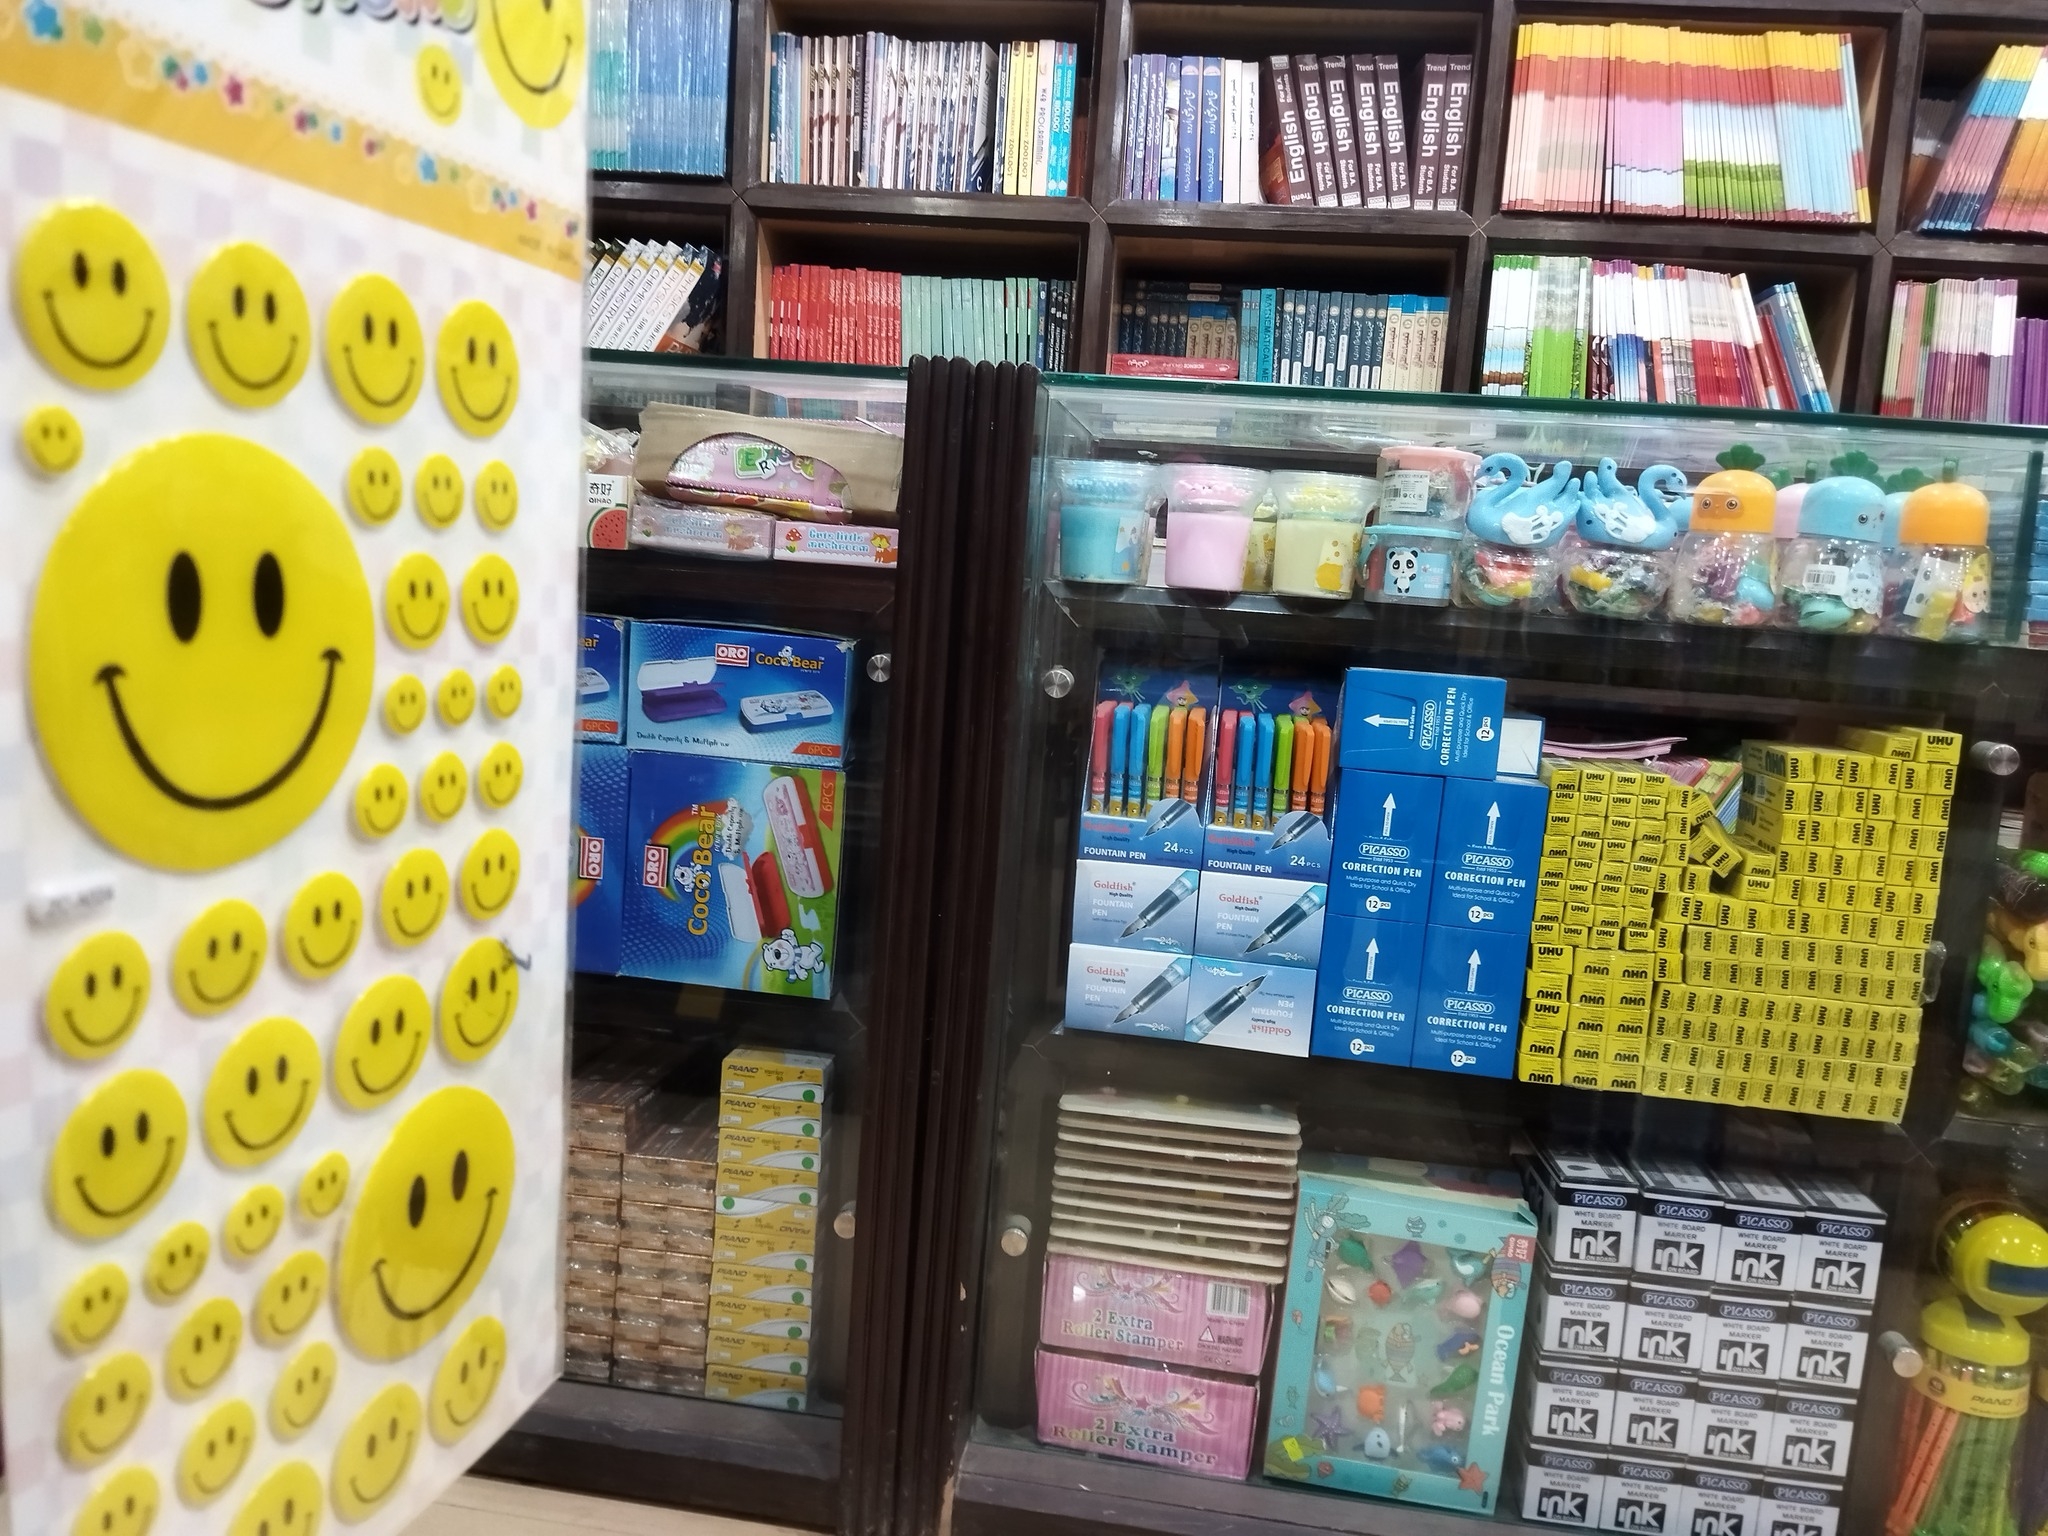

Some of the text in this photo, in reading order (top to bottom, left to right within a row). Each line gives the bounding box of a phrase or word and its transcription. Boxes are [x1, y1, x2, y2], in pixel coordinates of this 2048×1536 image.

[1299, 63, 1318, 72] Trend
[1052, 100, 1061, 134] BIOLOGY
[1062, 100, 1071, 134] BIOLOGY
[1305, 82, 1328, 154] English
[1330, 80, 1352, 152] English
[1359, 82, 1380, 155] English
[1382, 82, 1404, 154] English
[1421, 84, 1443, 157] English
[1445, 83, 1467, 156] English
[1281, 110, 1305, 183] English
[1021, 140, 1029, 179] ZOOLOGY
[1316, 162, 1324, 191] Students
[1418, 165, 1426, 194] Students
[1442, 164, 1450, 194] Students
[1291, 193, 1311, 202] Trend
[606, 268, 642, 322] CHEMISTRY
[624, 268, 659, 323] CHEMISTRY
[662, 273, 696, 321] PHYSICS
[1262, 293, 1272, 364] MATHEMATICAL
[717, 645, 824, 670] ORO Coco Bear
[585, 722, 611, 732] 6PCS
[1422, 703, 1434, 747] PICASSO
[1440, 687, 1456, 765] CORRECTION PEN
[1481, 730, 1489, 739] 12
[1927, 735, 1954, 746] UHU
[808, 745, 832, 756] 6PCS
[1791, 758, 1799, 779] UHU
[1586, 773, 1605, 781] UHU
[1617, 776, 1636, 784] UHU
[1646, 775, 1665, 784] UHU
[824, 782, 833, 812] 6PCS
[1612, 820, 1631, 828] UHU
[1084, 847, 1146, 860] FOUNTAIN PEN
[1163, 842, 1178, 853] 24
[1362, 845, 1406, 857] PICASSO
[588, 840, 600, 876] ORO
[1290, 856, 1305, 867] 24
[1465, 854, 1510, 867] PICASSO
[1713, 852, 1729, 867] UHU
[646, 849, 660, 884] ORO
[687, 806, 716, 936] Coco Bear
[1208, 860, 1272, 873] FOUNTAIN PEN
[1342, 862, 1422, 877] CORRECTION PEN
[1445, 871, 1526, 887] CORRECTION PEN
[1748, 879, 1770, 889] UHU
[1093, 880, 1133, 892] Goldfish
[1092, 899, 1134, 909] FOUNTAIN
[1219, 893, 1259, 906] Goldfish
[1368, 901, 1378, 909] 12
[1092, 908, 1108, 916] PEN
[1217, 912, 1259, 923] FOUNTAIN
[1216, 922, 1233, 931] PEN
[1284, 953, 1299, 961] 24
[1538, 947, 1563, 956] UHU
[1086, 966, 1126, 977] Goldfish
[1584, 965, 1609, 975] UHU
[1622, 969, 1648, 979] UHU
[1085, 984, 1126, 995] FOUNTAIN
[1346, 988, 1390, 1001] PICASSO
[1536, 990, 1562, 1000] UHU
[1085, 993, 1100, 1002] PEN
[1278, 1000, 1294, 1008] PEN
[1620, 996, 1645, 1006] UHU
[1251, 1007, 1293, 1018] FOUNTAIN
[1446, 999, 1492, 1013] PICASSO
[1535, 1004, 1560, 1014] UHU
[1327, 1005, 1405, 1022] CORRECTION PEN
[1251, 1025, 1292, 1036] Goldfish
[1427, 1016, 1507, 1033] CORRECTION PEN
[1530, 1044, 1554, 1055] UHU
[727, 1064, 759, 1075] PIANO
[1612, 1079, 1636, 1089] UHU
[724, 1098, 756, 1109] PIANO
[1574, 1194, 1624, 1207] PICASSO
[1574, 1210, 1622, 1220] WHITE BOARD
[1658, 1204, 1709, 1220] PICASSO
[1581, 1219, 1613, 1228] MARKER
[1738, 1215, 1790, 1230] PICASSO
[1663, 1231, 1697, 1240] MARKER
[1819, 1223, 1871, 1238] PICASSO
[719, 1234, 750, 1244] PIANO
[1573, 1229, 1618, 1259] ink
[1654, 1242, 1700, 1271] ink
[1735, 1252, 1780, 1282] ink
[1815, 1261, 1862, 1290] ink
[1562, 1284, 1613, 1298] PICASSO
[1645, 1294, 1695, 1308] PICASSO
[1094, 1309, 1153, 1331] 2 Extra
[1063, 1320, 1184, 1352] Roller Stamper
[1481, 1324, 1515, 1437] Ocean Park
[1095, 1418, 1175, 1443] 2 Extra
[1053, 1425, 1217, 1466] Roller Stamper
